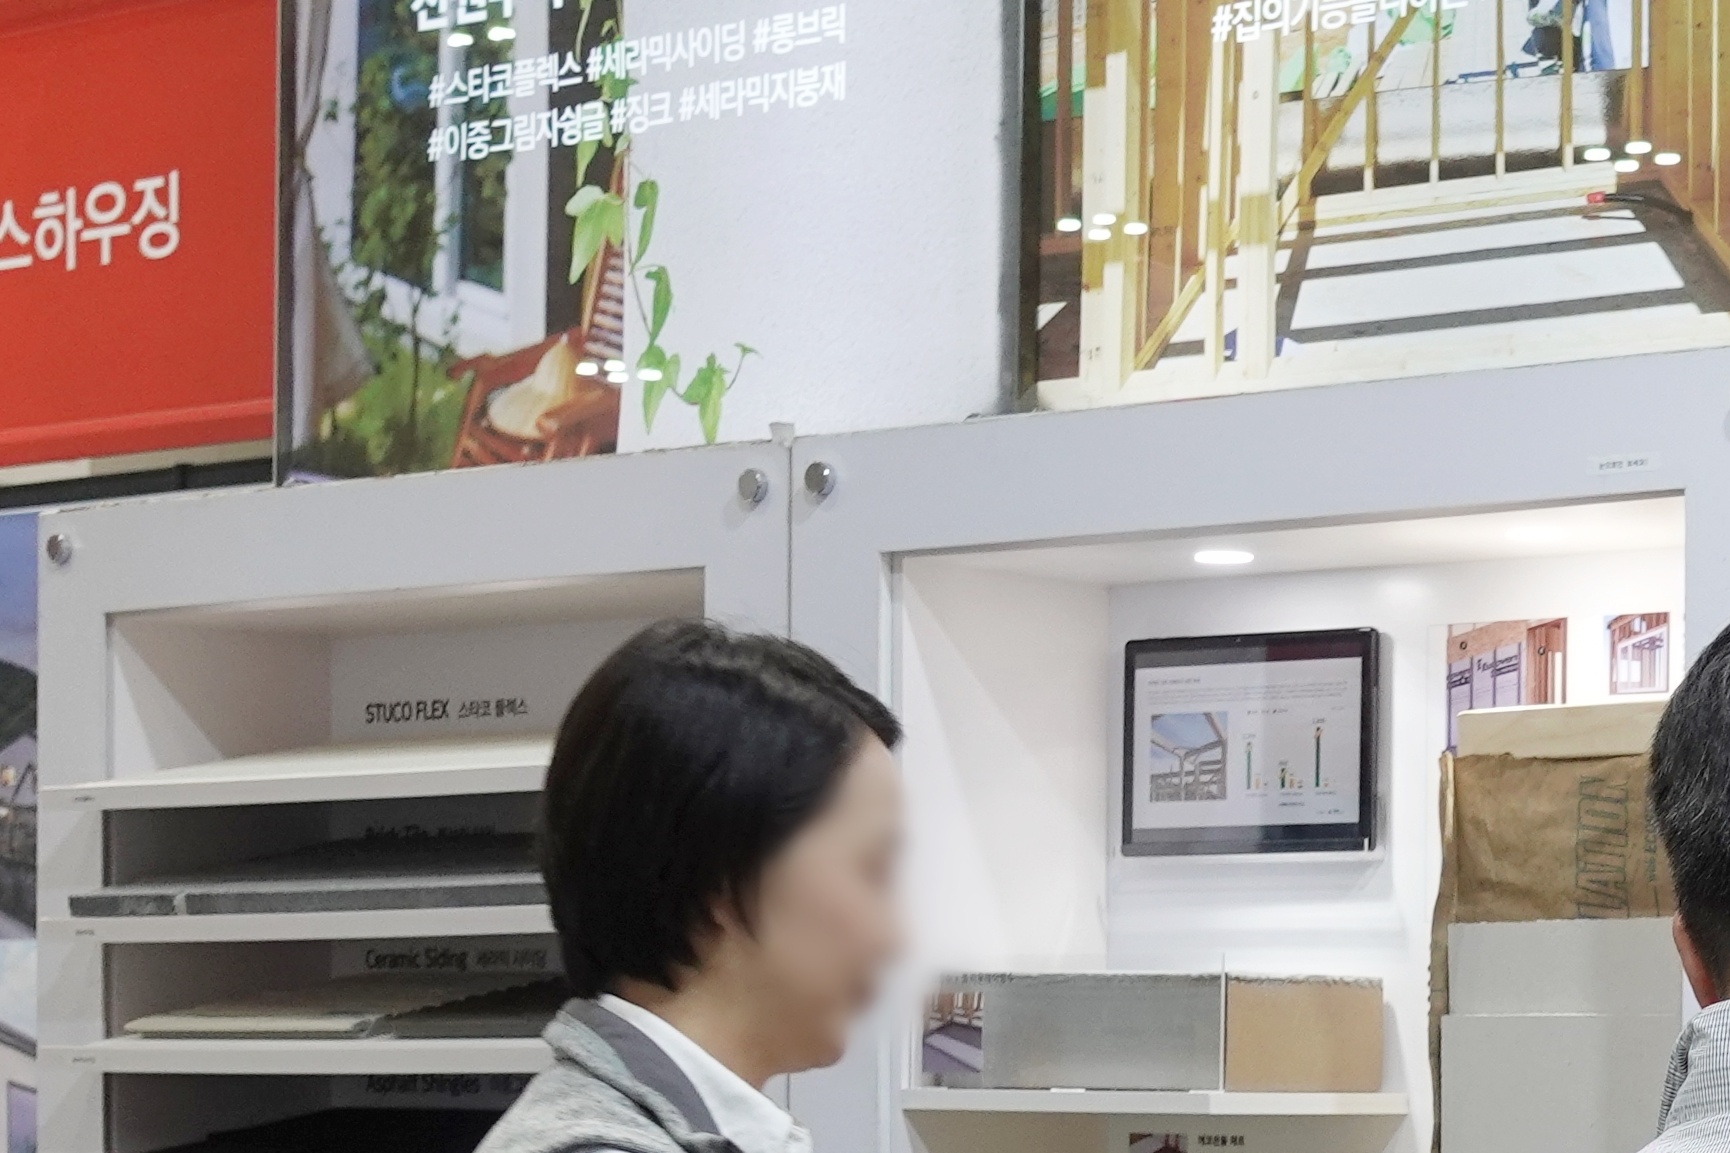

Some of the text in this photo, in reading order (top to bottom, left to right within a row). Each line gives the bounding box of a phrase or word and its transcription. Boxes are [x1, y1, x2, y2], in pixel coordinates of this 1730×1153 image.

[428, 4, 846, 109] #스타코플렉스 #세라믹사이딩 #롱브릭
[427, 62, 846, 162] #이중그림자슁글 #징크 #세라믹지붕재
[366, 701, 412, 723] STUCO
[415, 699, 449, 721] FLEX
